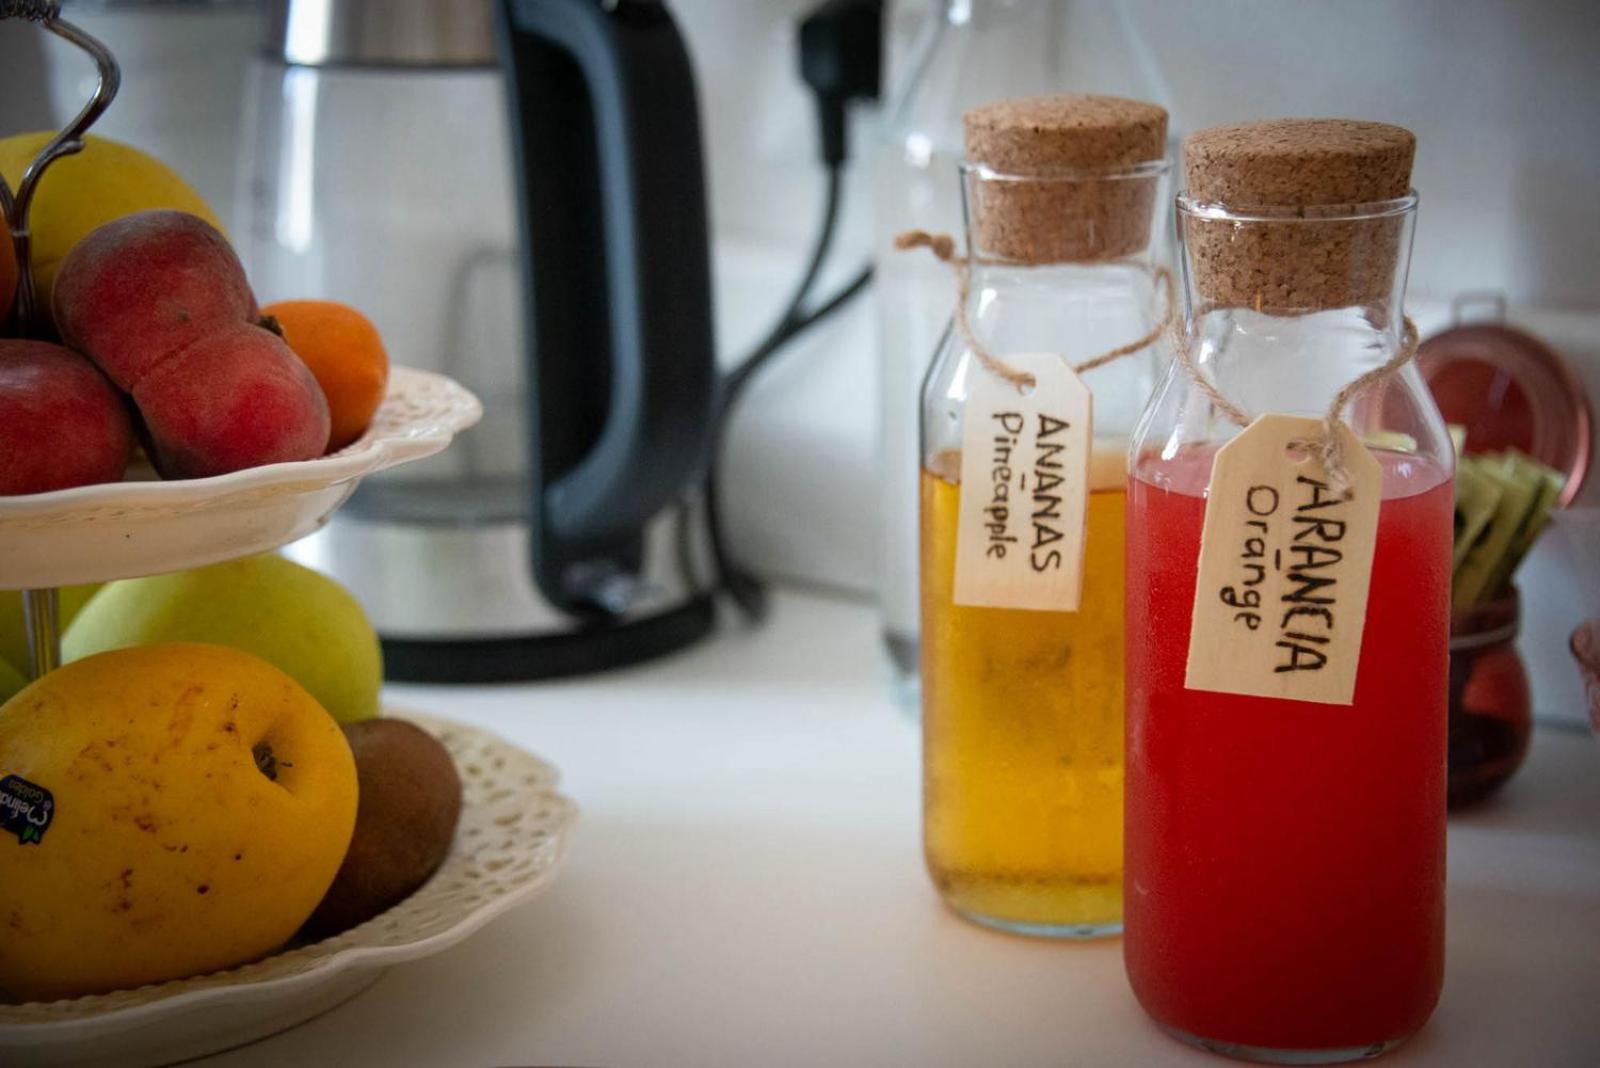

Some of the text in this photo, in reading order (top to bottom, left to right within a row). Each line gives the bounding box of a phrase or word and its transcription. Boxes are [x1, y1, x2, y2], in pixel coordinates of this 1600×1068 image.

[984, 412, 1024, 560] Pineapple
[1030, 413, 1070, 573] ANANAS
[1219, 485, 1279, 631] Orange
[1274, 475, 1346, 673] ARANCIA
